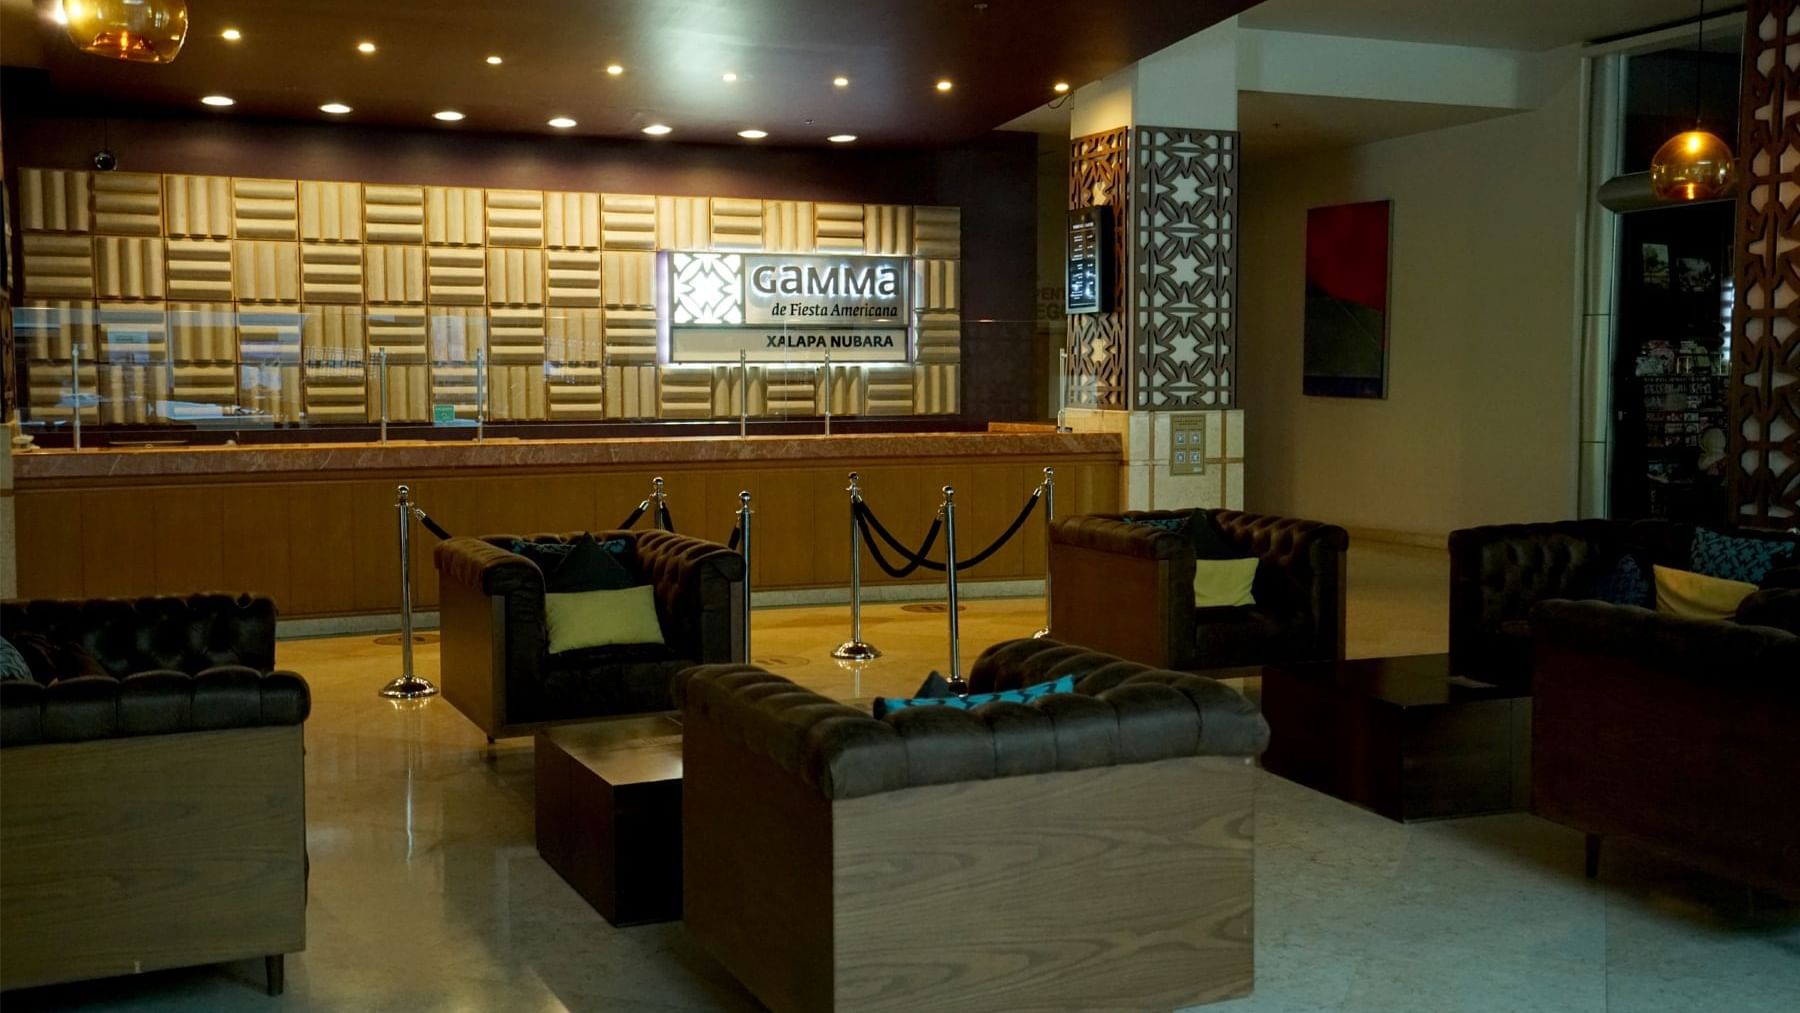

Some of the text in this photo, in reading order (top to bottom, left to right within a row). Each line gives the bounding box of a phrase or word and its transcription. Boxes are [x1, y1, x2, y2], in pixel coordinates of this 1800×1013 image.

[771, 302, 898, 317] de Fiesta Americana
[766, 335, 894, 348] XALAPA NUBARA
